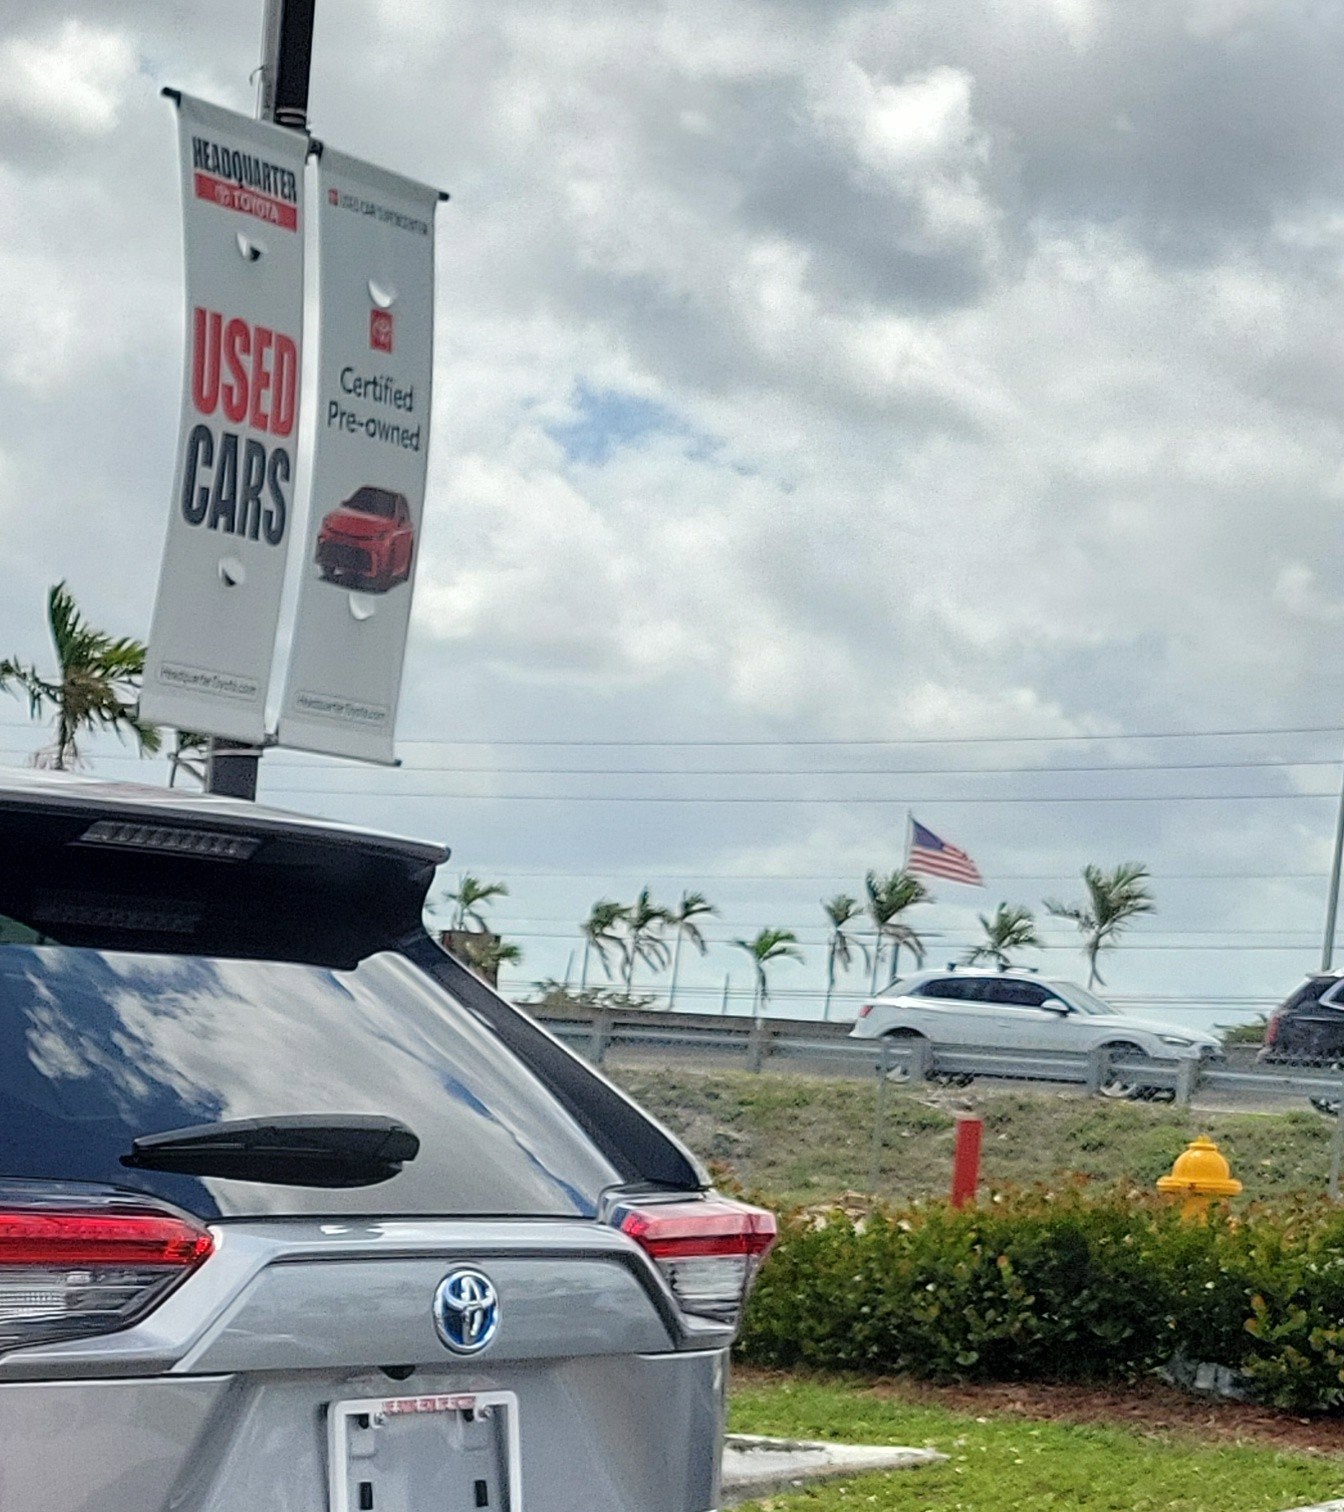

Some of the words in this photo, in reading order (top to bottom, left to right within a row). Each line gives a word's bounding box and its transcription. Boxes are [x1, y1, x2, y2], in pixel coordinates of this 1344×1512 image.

[192, 136, 298, 204] HEADQUARTER
[233, 191, 280, 223] TOYOTA
[191, 306, 298, 438] USED
[339, 365, 415, 413] Certified
[327, 399, 421, 453] Pre-owned
[181, 423, 291, 547] CARS
